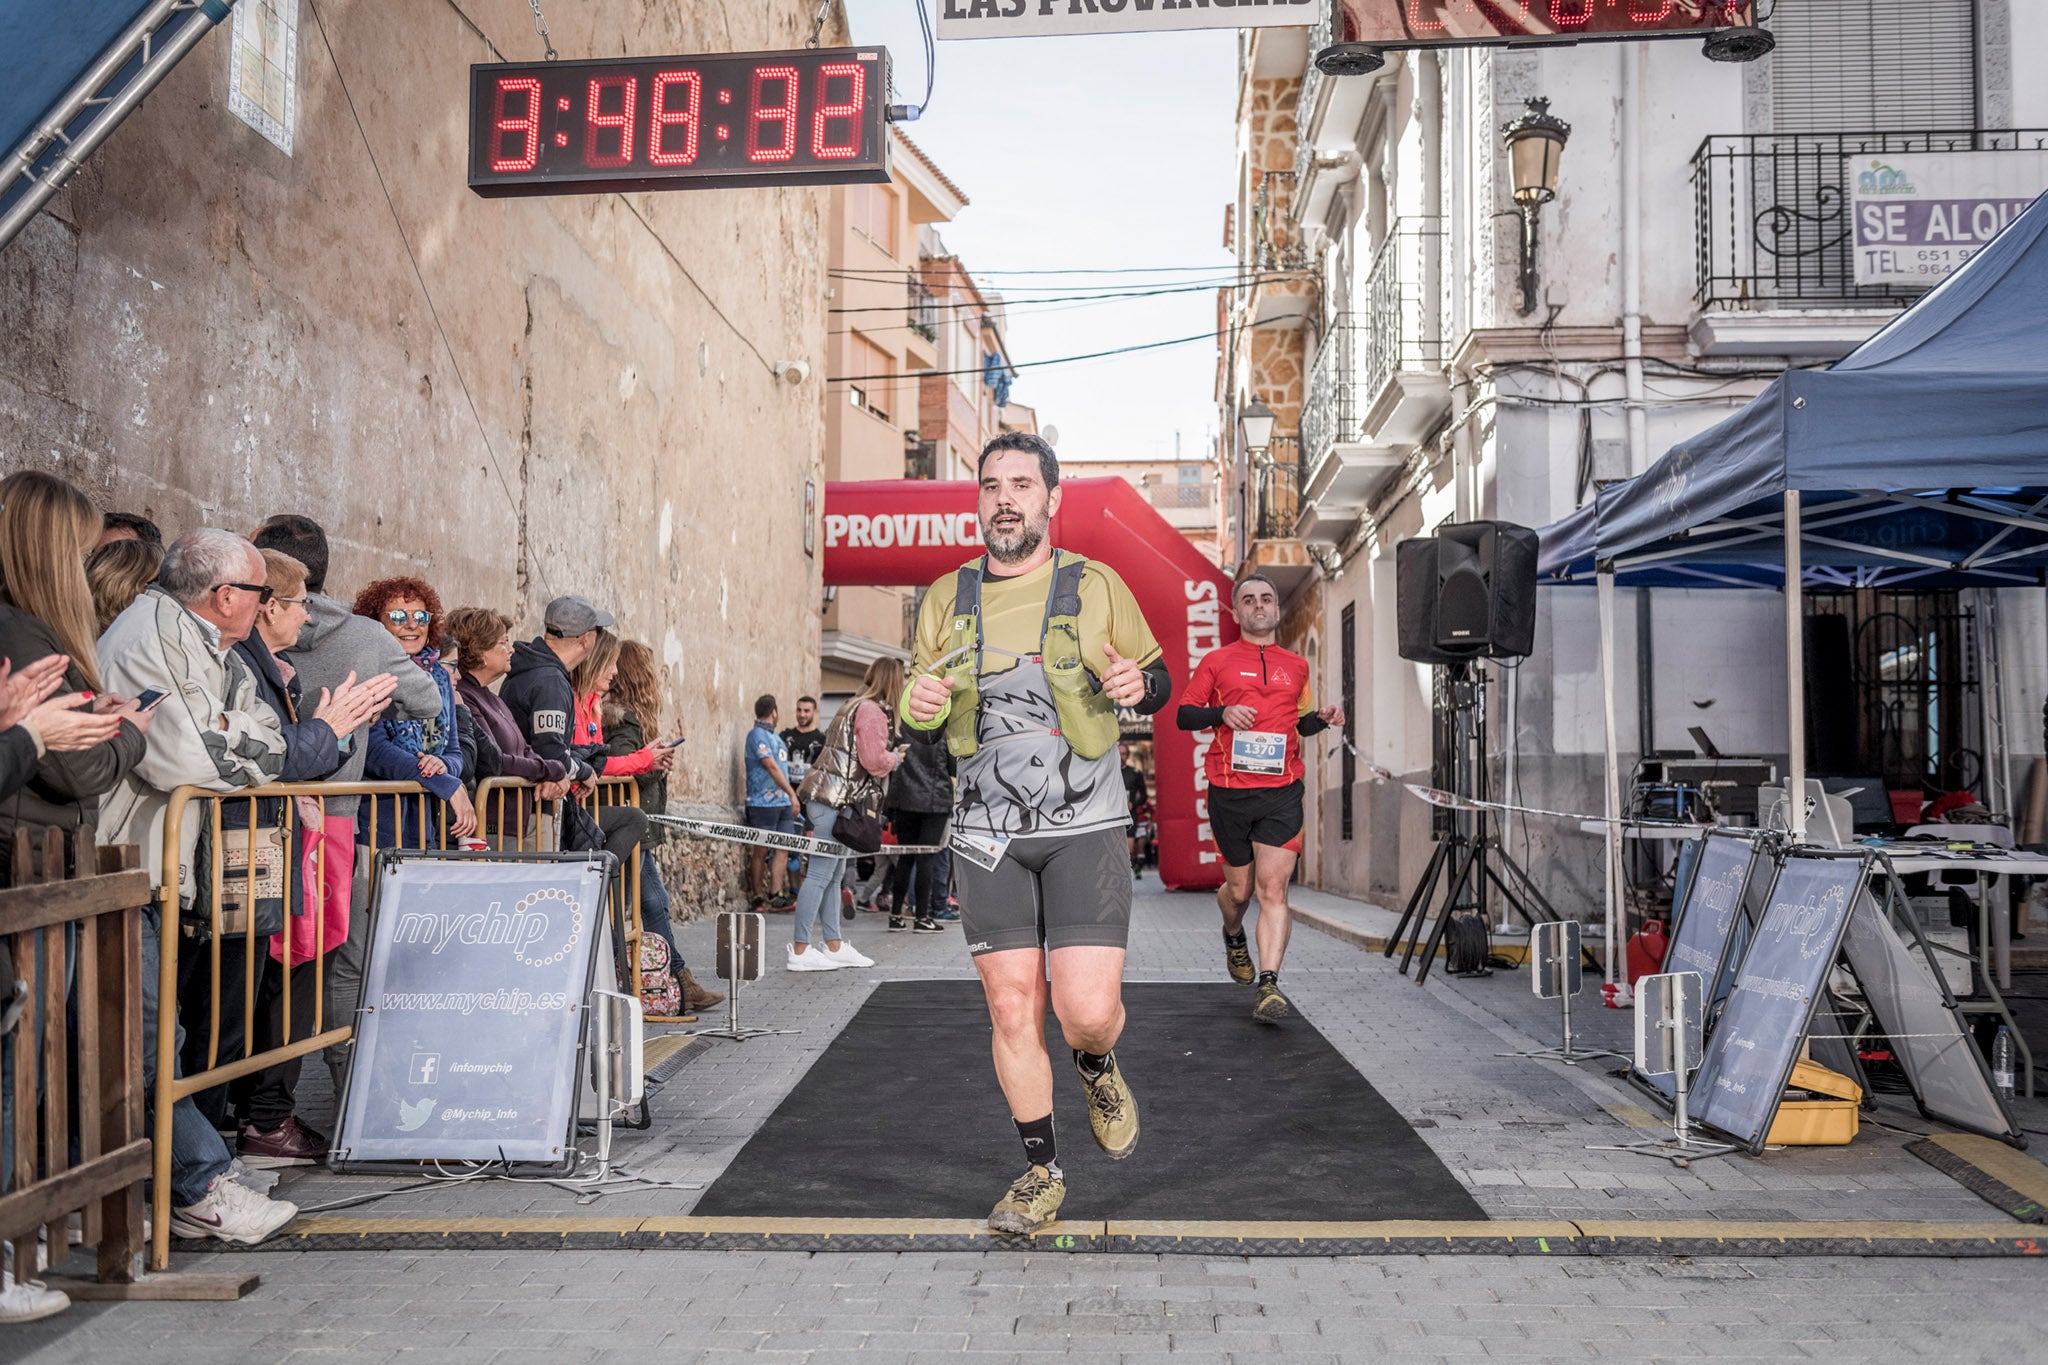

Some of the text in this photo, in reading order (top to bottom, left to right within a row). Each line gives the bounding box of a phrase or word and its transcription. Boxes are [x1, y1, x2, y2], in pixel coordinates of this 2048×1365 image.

[493, 63, 865, 172] 3:48:32
[1862, 205, 1907, 241] SE
[1917, 250, 1950, 261] 651
[1244, 744, 1276, 756] 1370
[394, 902, 549, 954] mychip
[382, 989, 567, 1015] www.mychip.es
[449, 1061, 513, 1074] /infomychip
[441, 1107, 518, 1121] @Mychip_Info
